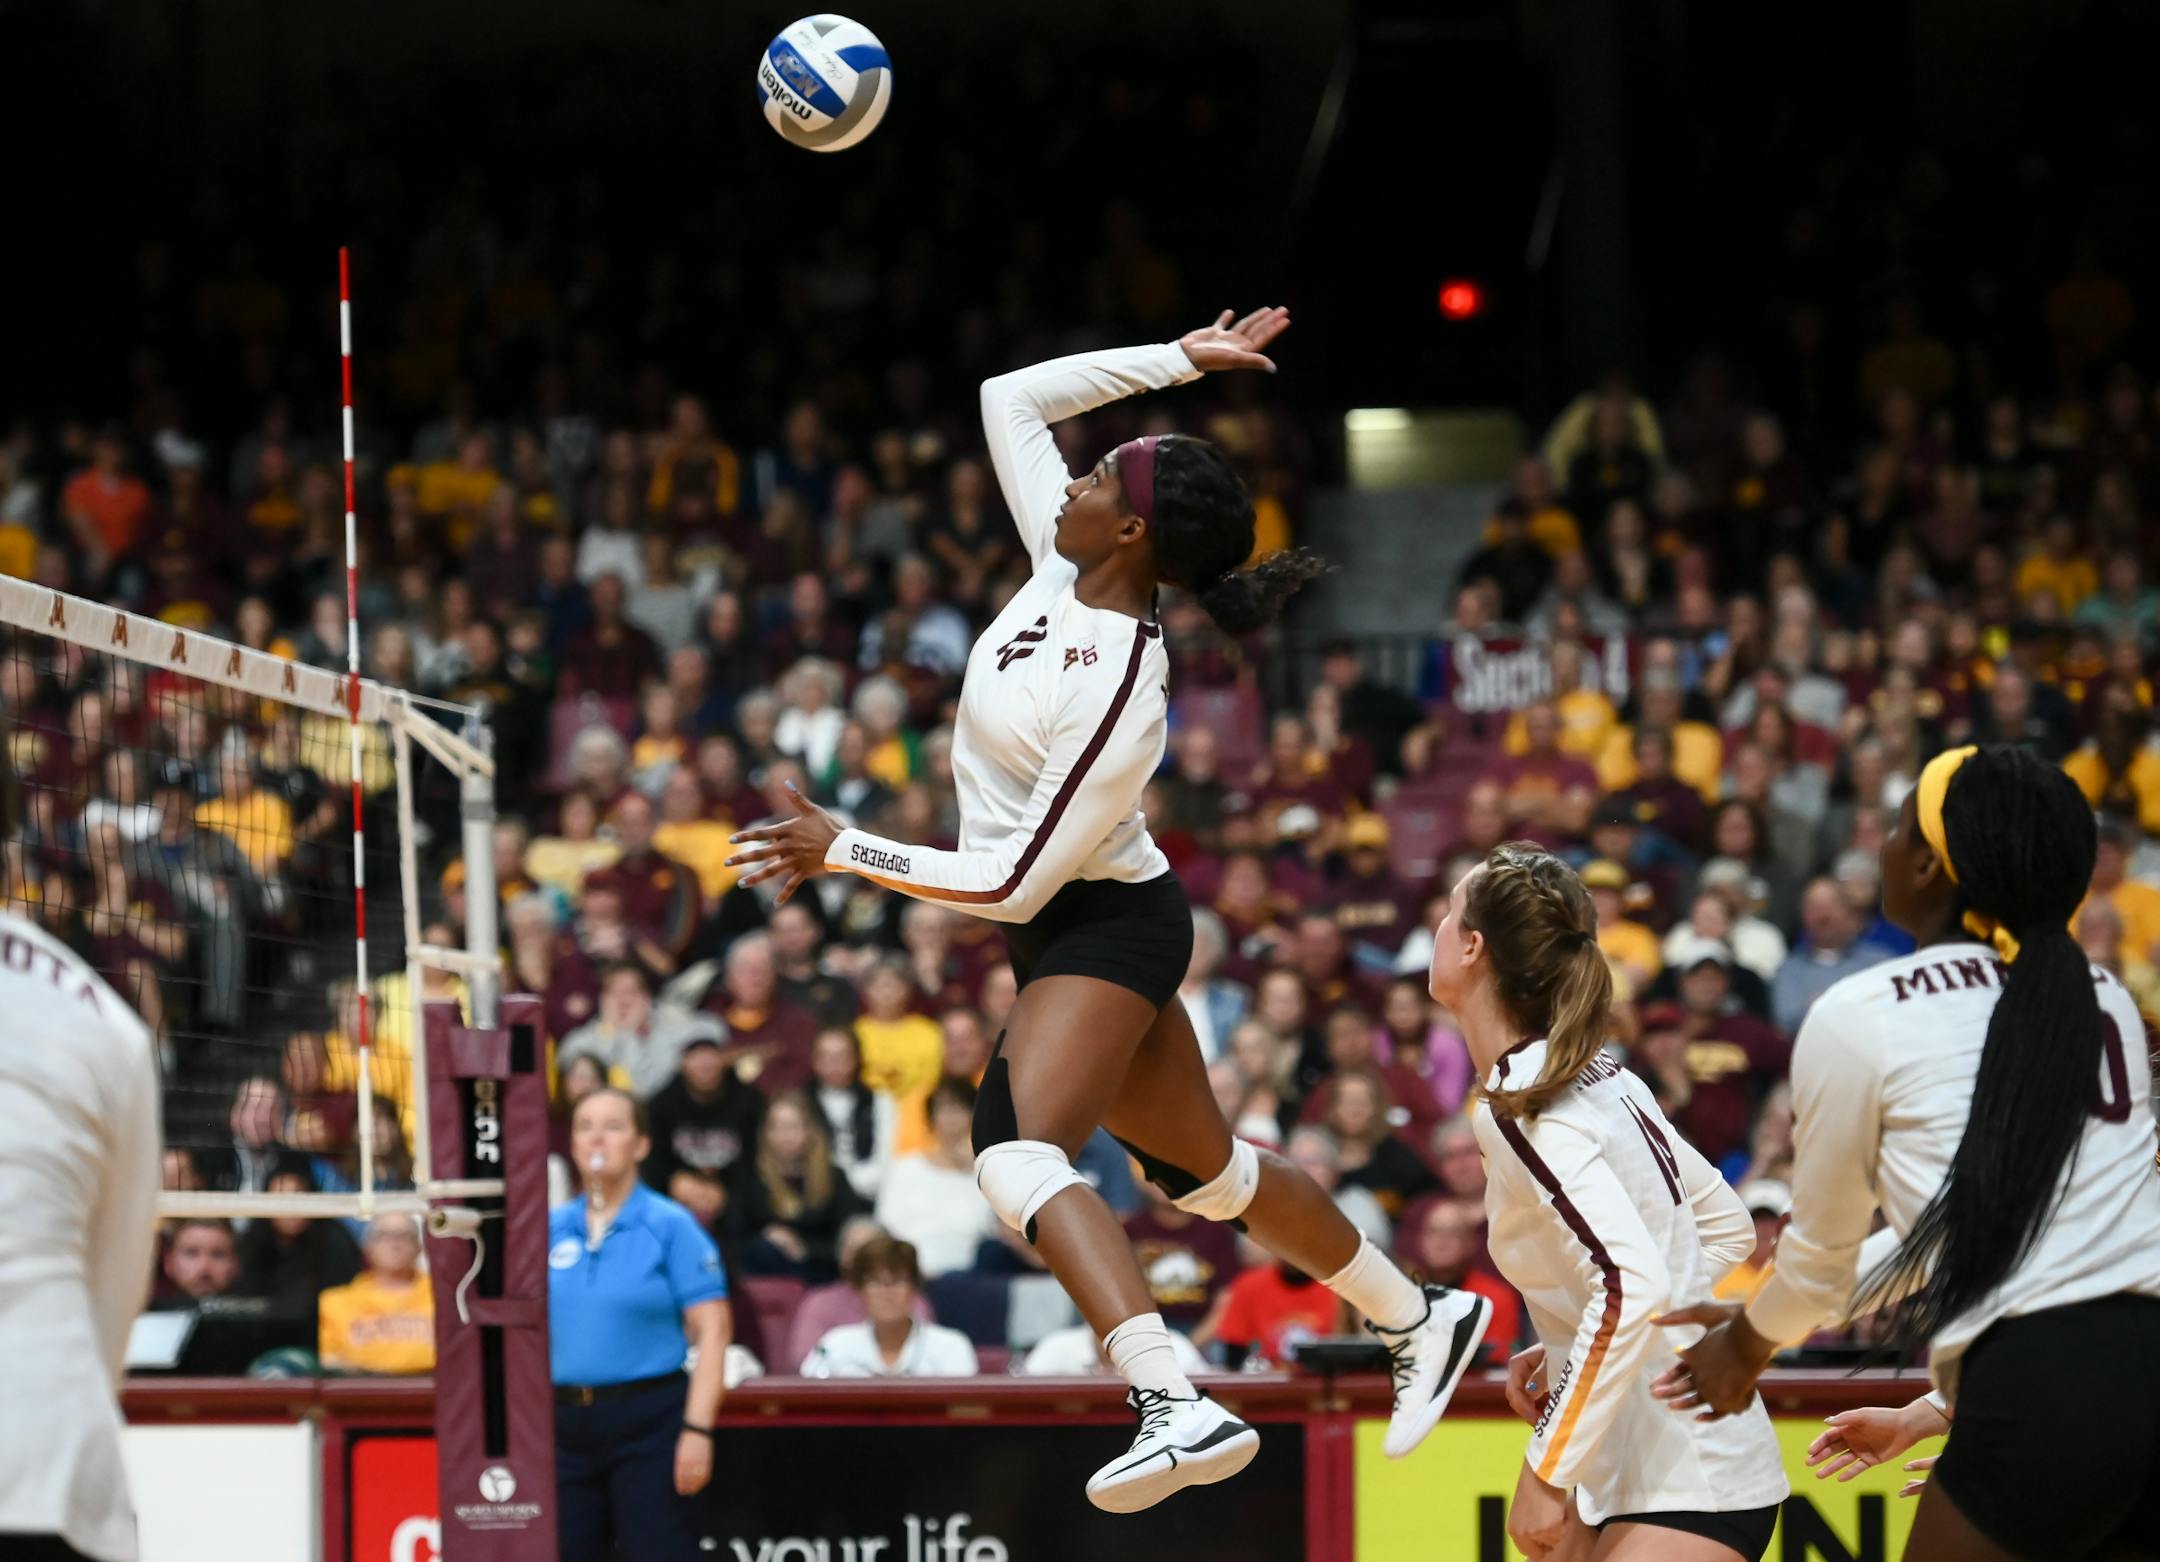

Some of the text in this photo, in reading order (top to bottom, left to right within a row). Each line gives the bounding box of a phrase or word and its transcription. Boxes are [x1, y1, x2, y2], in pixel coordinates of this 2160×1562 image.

[761, 64, 813, 120] molten
[850, 843, 911, 874] GOPHERS
[903, 1513, 1009, 1562] life
